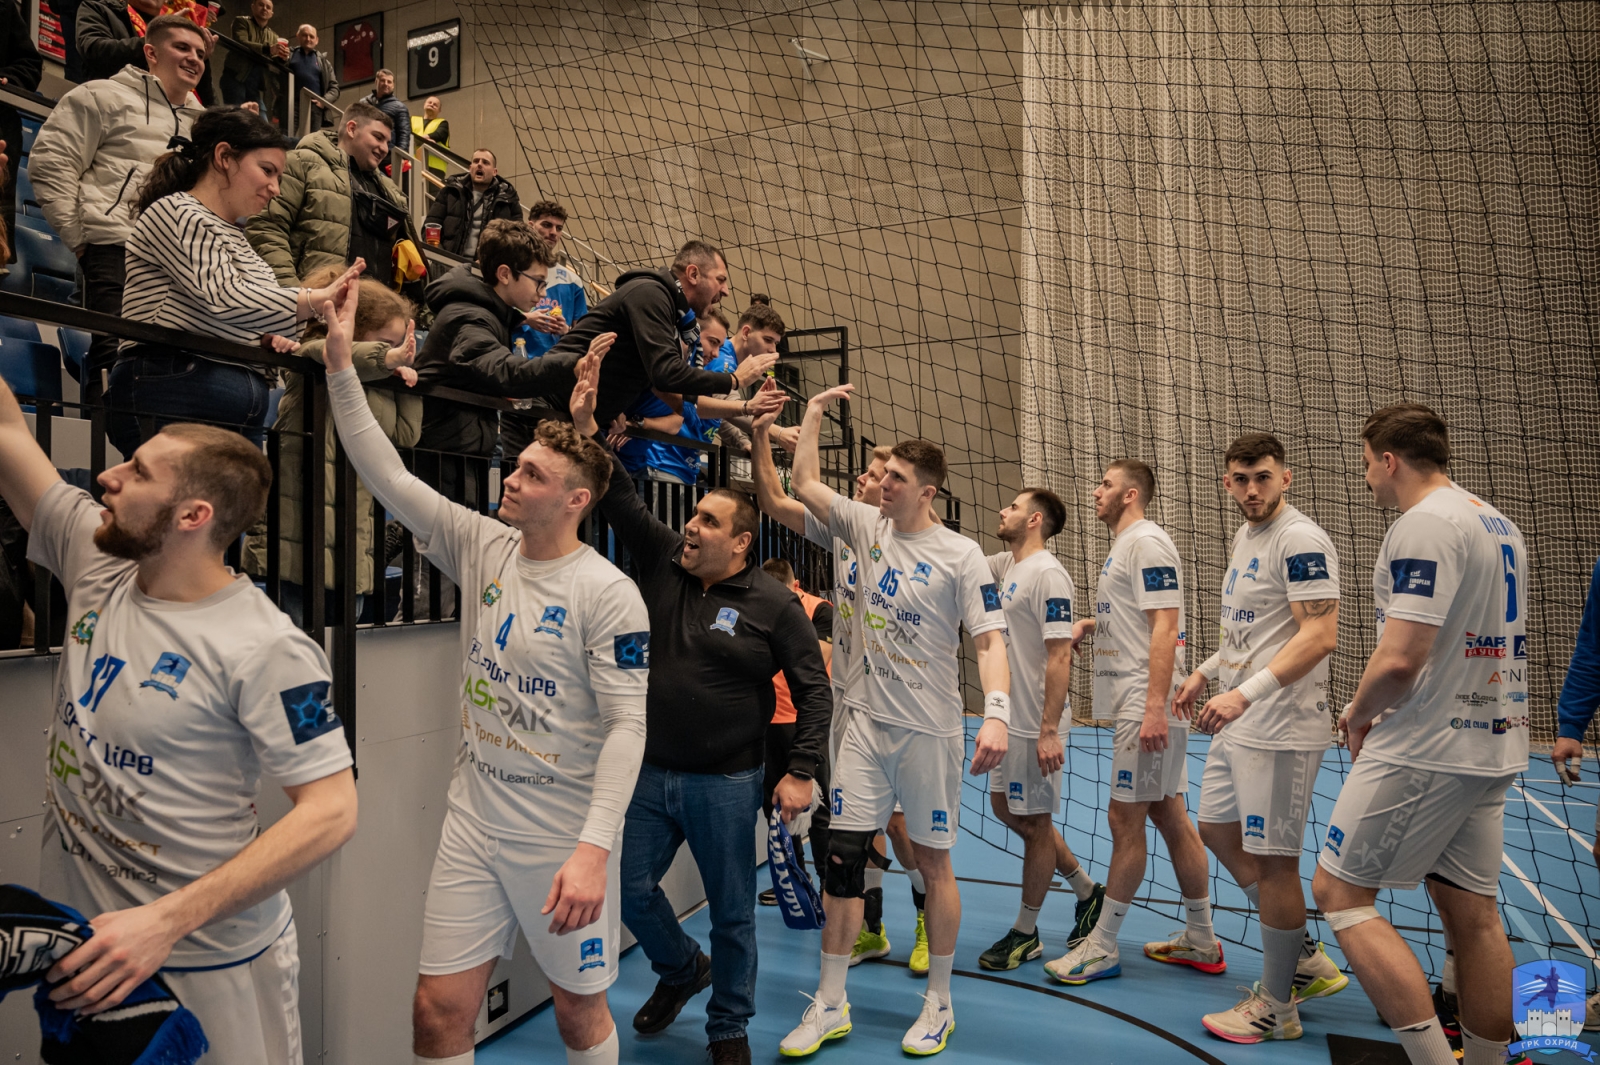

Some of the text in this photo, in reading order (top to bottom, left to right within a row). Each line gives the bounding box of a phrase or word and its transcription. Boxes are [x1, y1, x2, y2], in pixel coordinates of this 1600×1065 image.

[428, 46, 439, 68] 9
[877, 565, 904, 598] 45
[1501, 543, 1518, 623] 6
[494, 612, 516, 652] 4
[78, 653, 127, 714] 17
[474, 721, 561, 765] Трпе Инст
[500, 768, 555, 786] Learnica
[830, 787, 843, 816] 5
